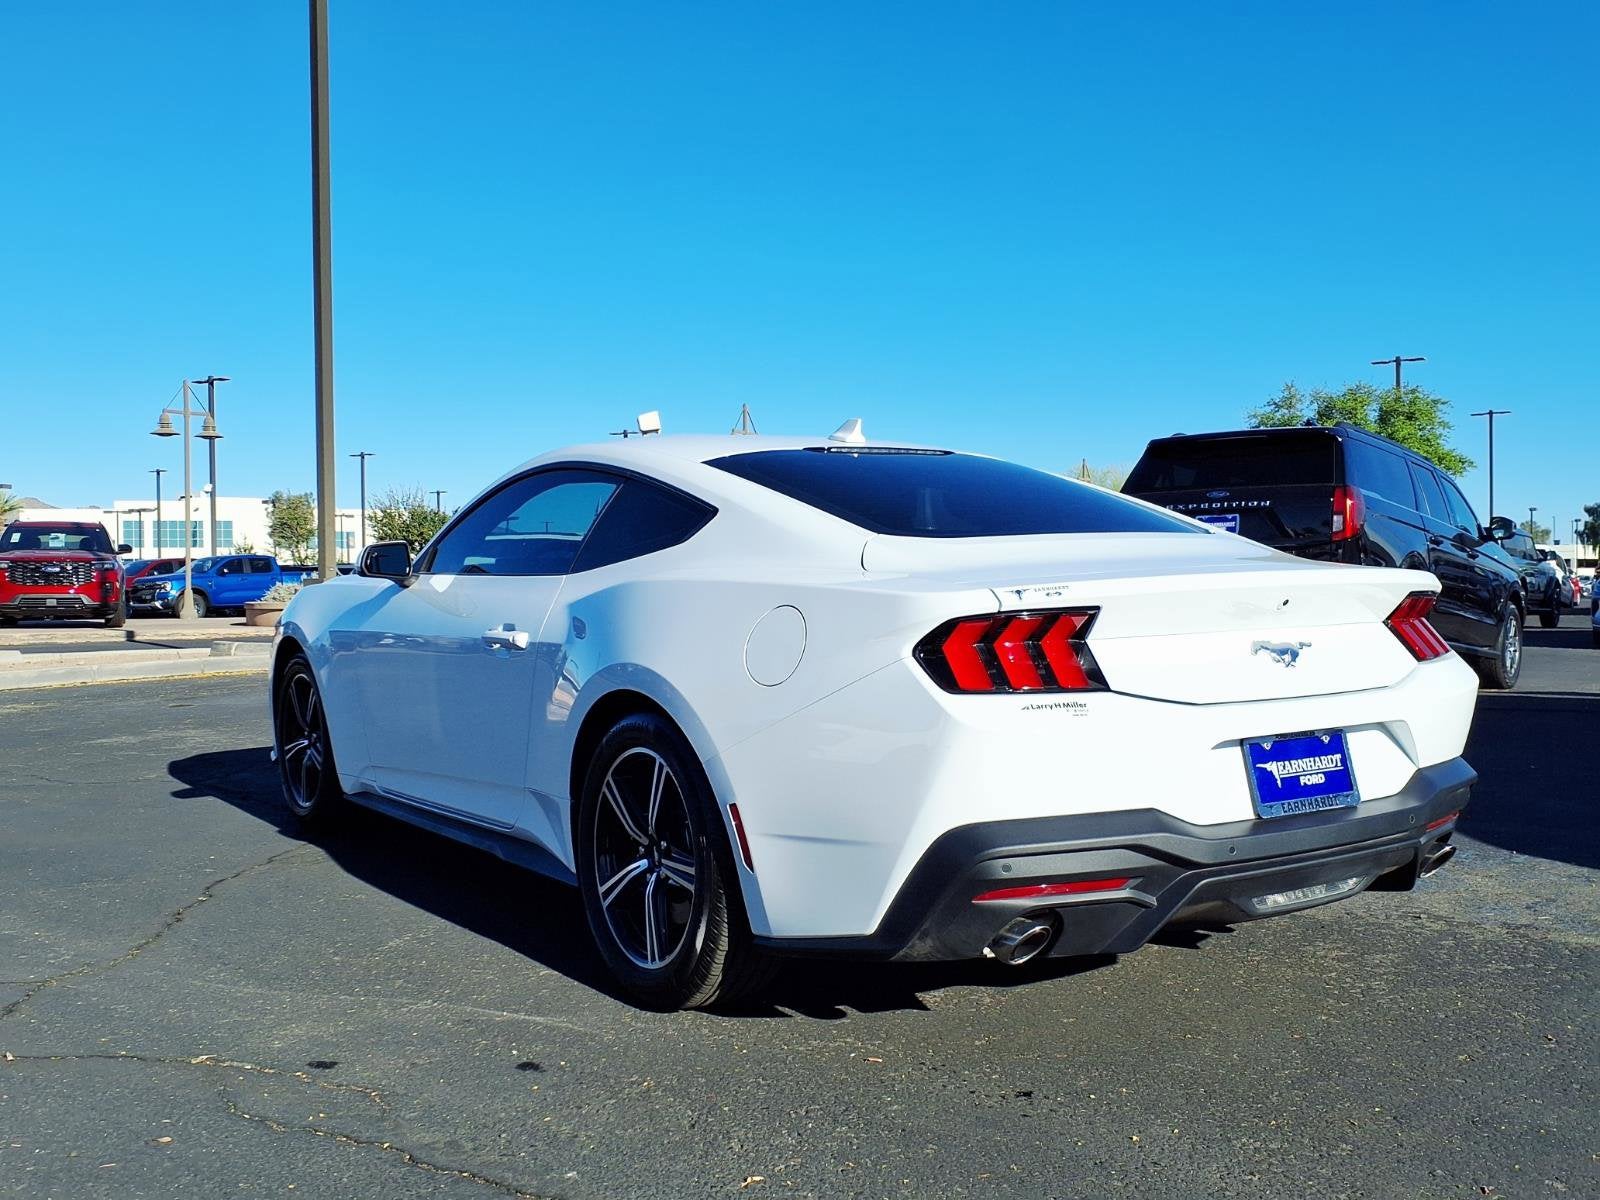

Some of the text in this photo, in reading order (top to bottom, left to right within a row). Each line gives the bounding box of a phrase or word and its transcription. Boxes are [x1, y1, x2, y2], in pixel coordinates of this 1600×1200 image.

[1166, 500, 1271, 510] EXPEDITION
[1030, 703, 1053, 711] Larry
[1277, 753, 1342, 774] EARNHARDT
[1299, 774, 1325, 786] FORD
[1281, 796, 1339, 814] EARNHARDT
